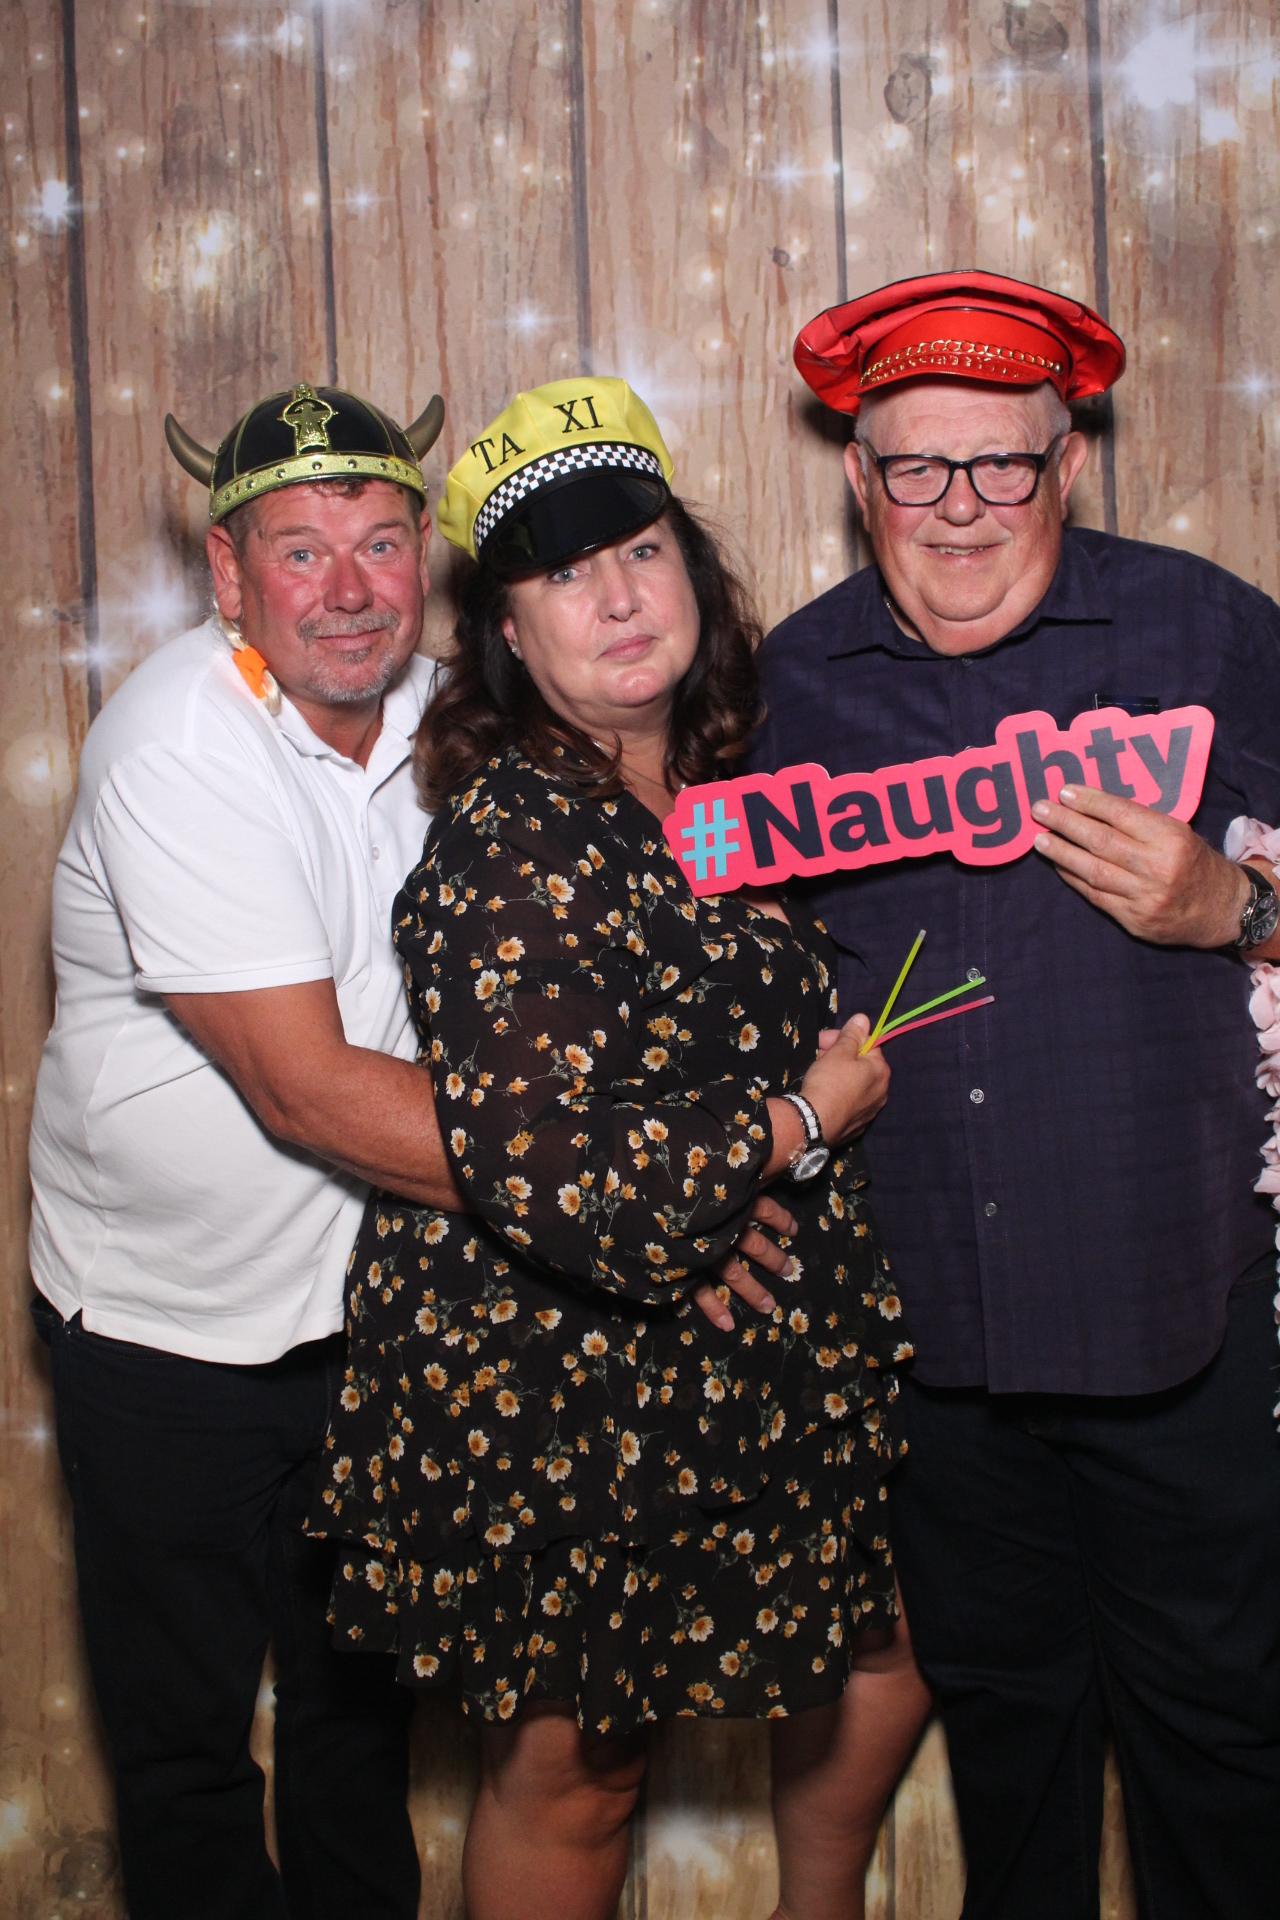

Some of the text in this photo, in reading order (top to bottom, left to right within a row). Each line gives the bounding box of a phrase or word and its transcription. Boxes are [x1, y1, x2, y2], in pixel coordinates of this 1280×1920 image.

[470, 396, 603, 474] TA XI
[681, 725, 1192, 880] #Naughty
